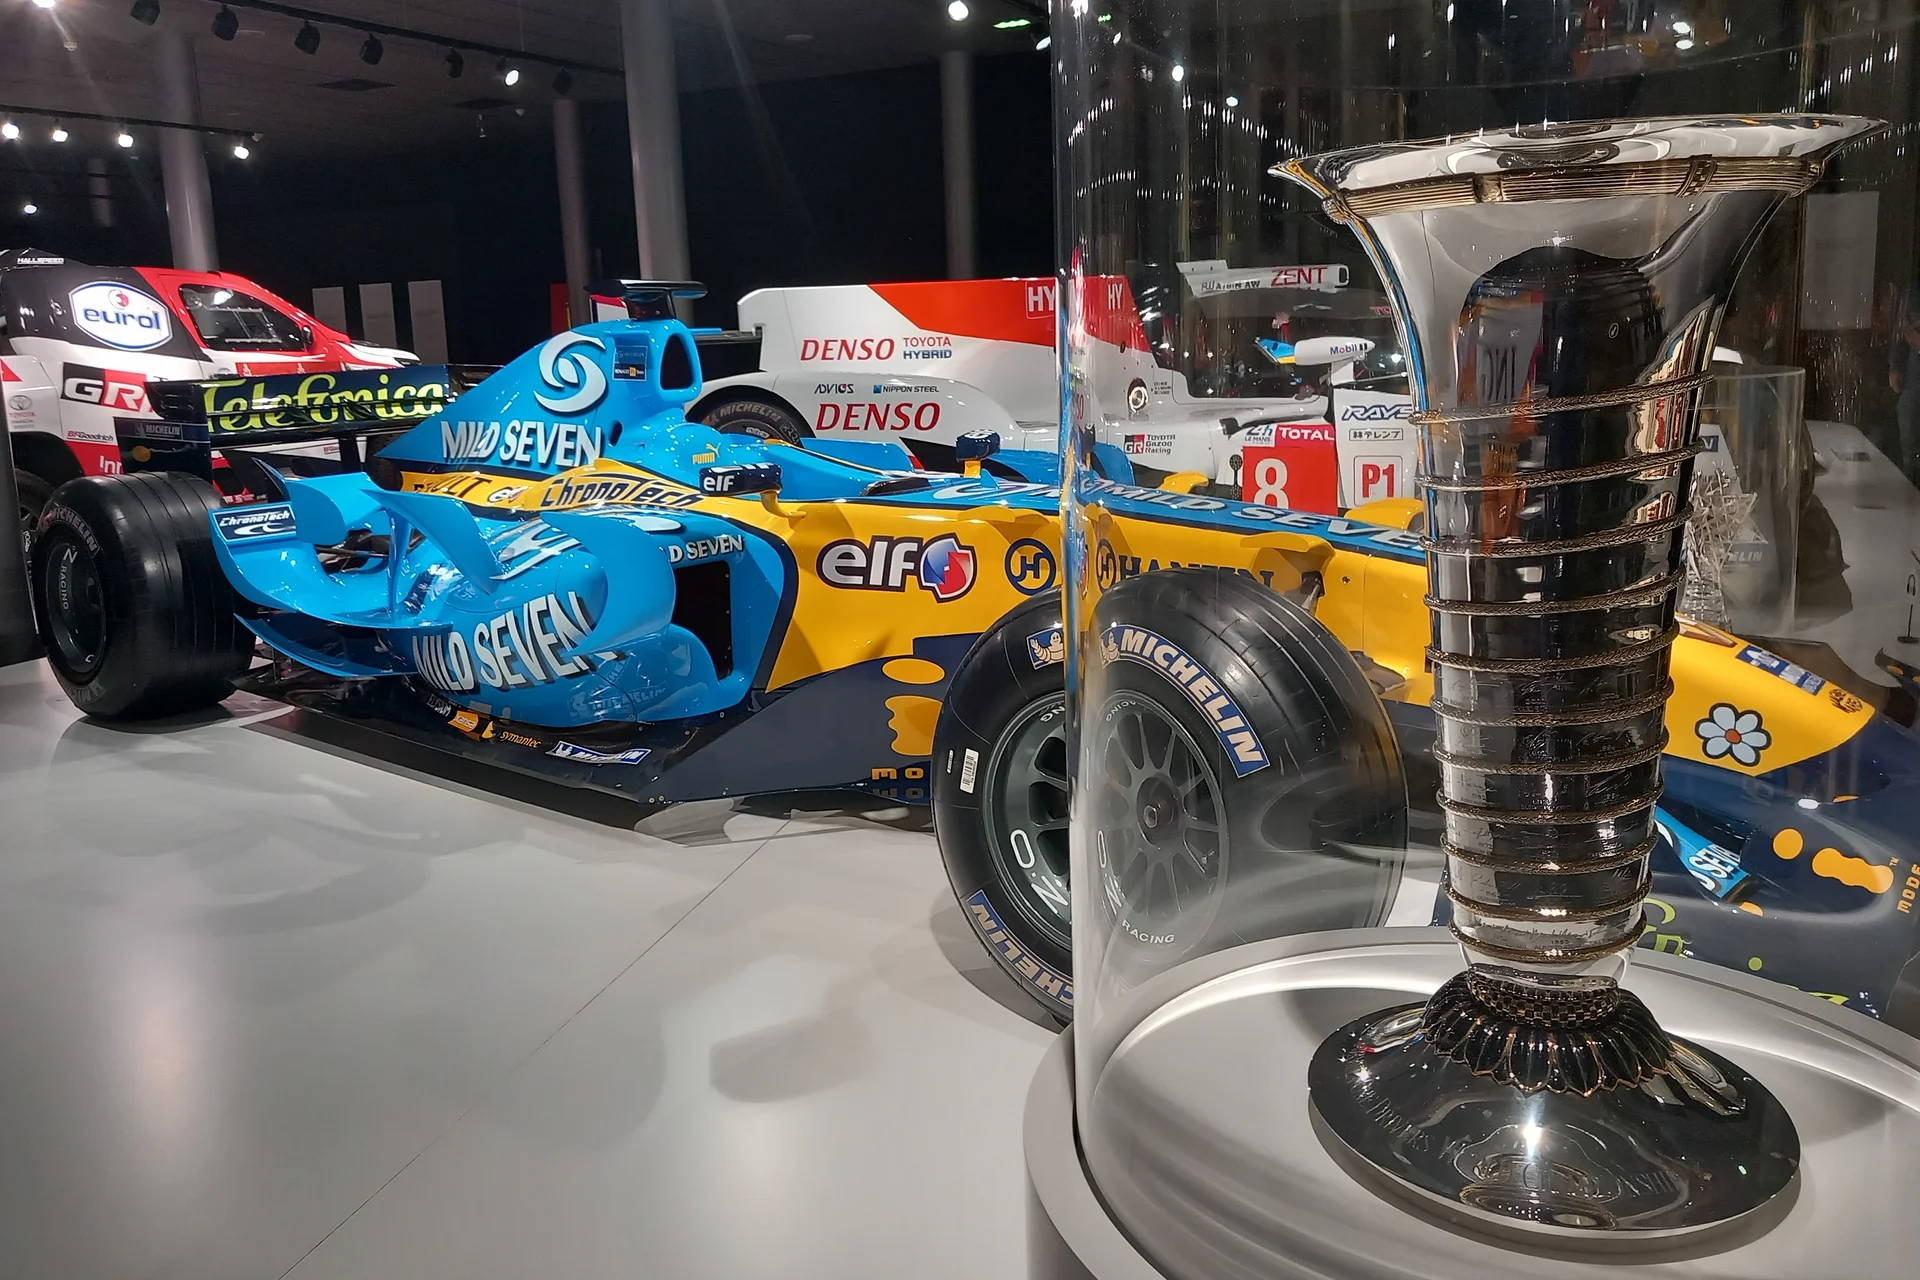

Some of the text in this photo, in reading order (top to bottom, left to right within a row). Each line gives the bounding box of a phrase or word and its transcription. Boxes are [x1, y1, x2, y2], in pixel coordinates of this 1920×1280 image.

[1271, 267, 1328, 287] ZENT
[83, 307, 162, 330] eurol
[800, 338, 896, 361] DENSO
[903, 337, 952, 347] TOYOTA
[1329, 344, 1358, 356] Mobil
[903, 349, 953, 360] HYBRID
[63, 378, 146, 412] GR
[883, 385, 940, 393] NIPPON STEEL
[720, 403, 782, 423] MICHELIN
[815, 402, 941, 431] DENSO
[146, 425, 180, 436] MICHELIN
[1278, 427, 1335, 442] TOTAL
[441, 419, 602, 468] MILD SEVEN
[692, 452, 716, 465] PUMA
[703, 475, 735, 492] elf
[1254, 458, 1290, 510] 8
[1362, 463, 1396, 499] P1
[1110, 484, 1425, 551] MILD SEVE
[685, 534, 743, 560] SEVEN
[821, 536, 918, 587] elf
[1119, 628, 1264, 767] MICHELIN
[500, 730, 541, 749] symantec
[1121, 918, 1176, 944] RACING
